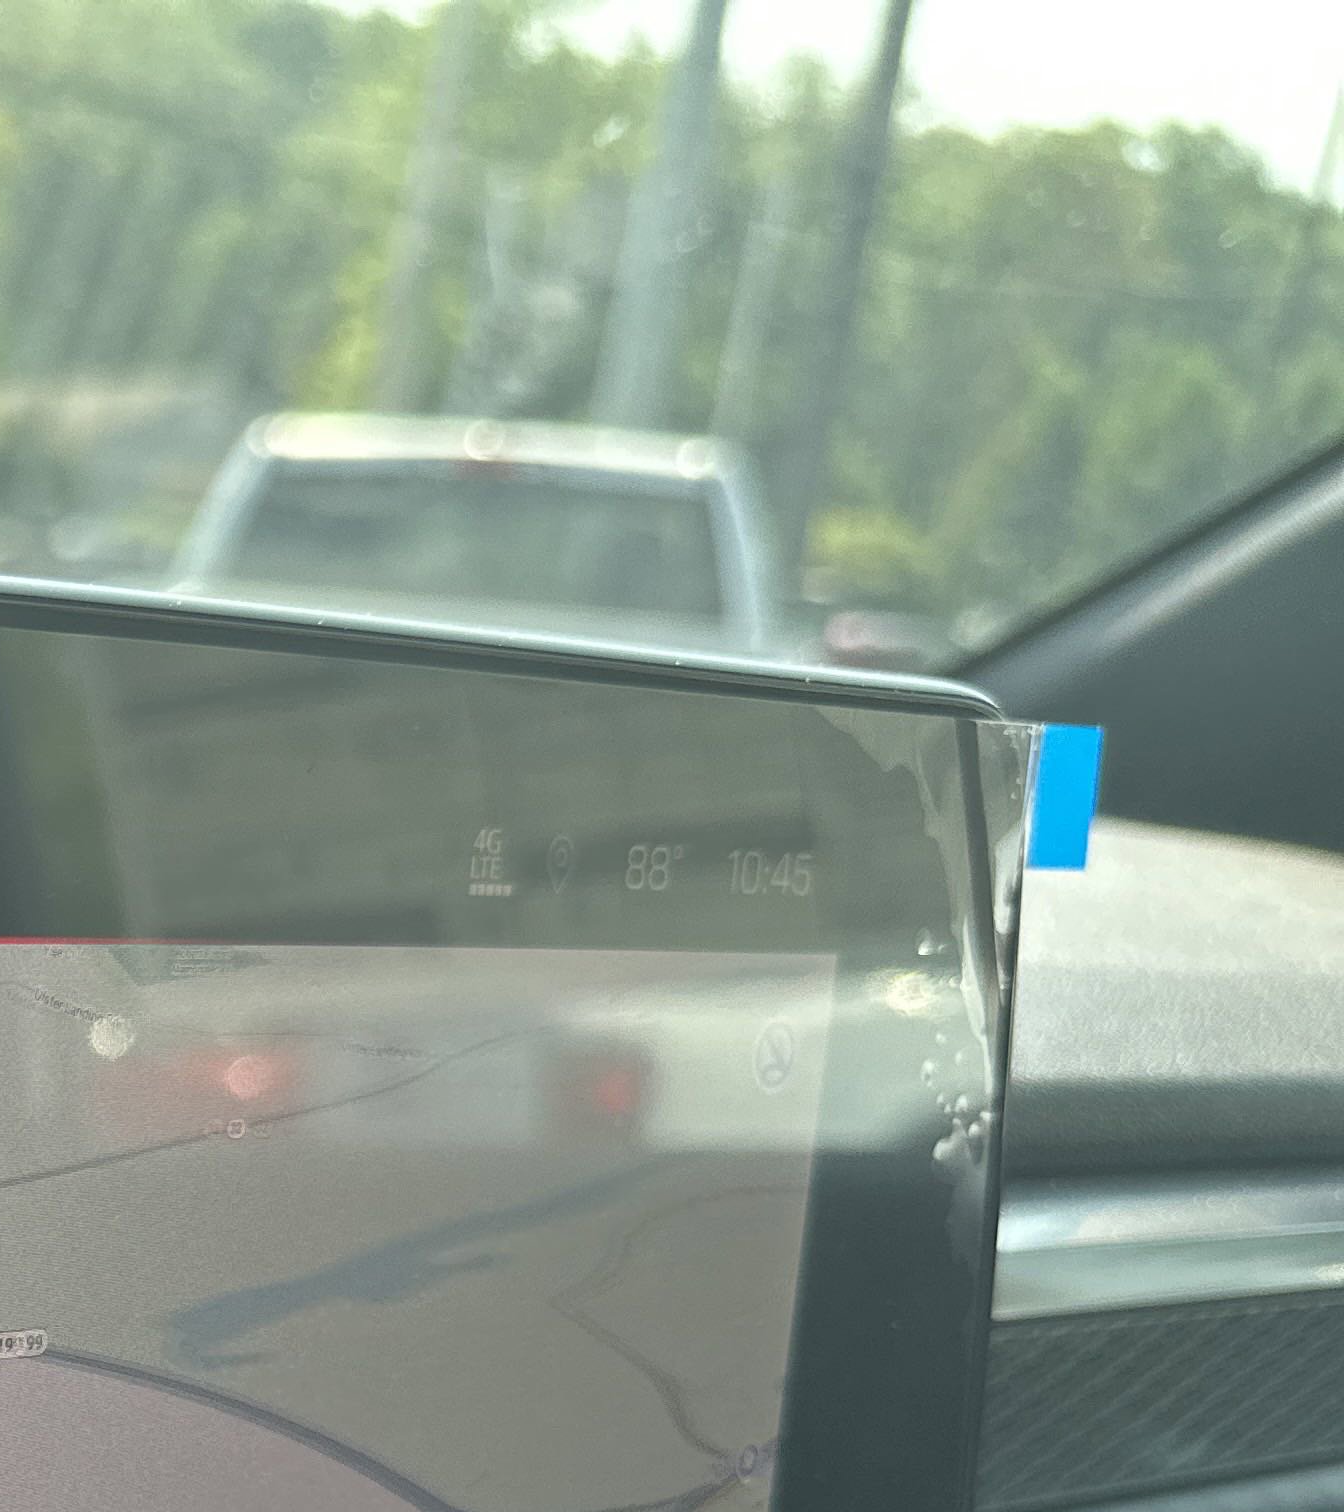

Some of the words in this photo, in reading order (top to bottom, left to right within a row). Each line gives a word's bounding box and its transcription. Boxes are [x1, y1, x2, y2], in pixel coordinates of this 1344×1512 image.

[472, 828, 503, 855] 4G
[469, 856, 504, 880] LTE
[728, 850, 812, 896] 10:45
